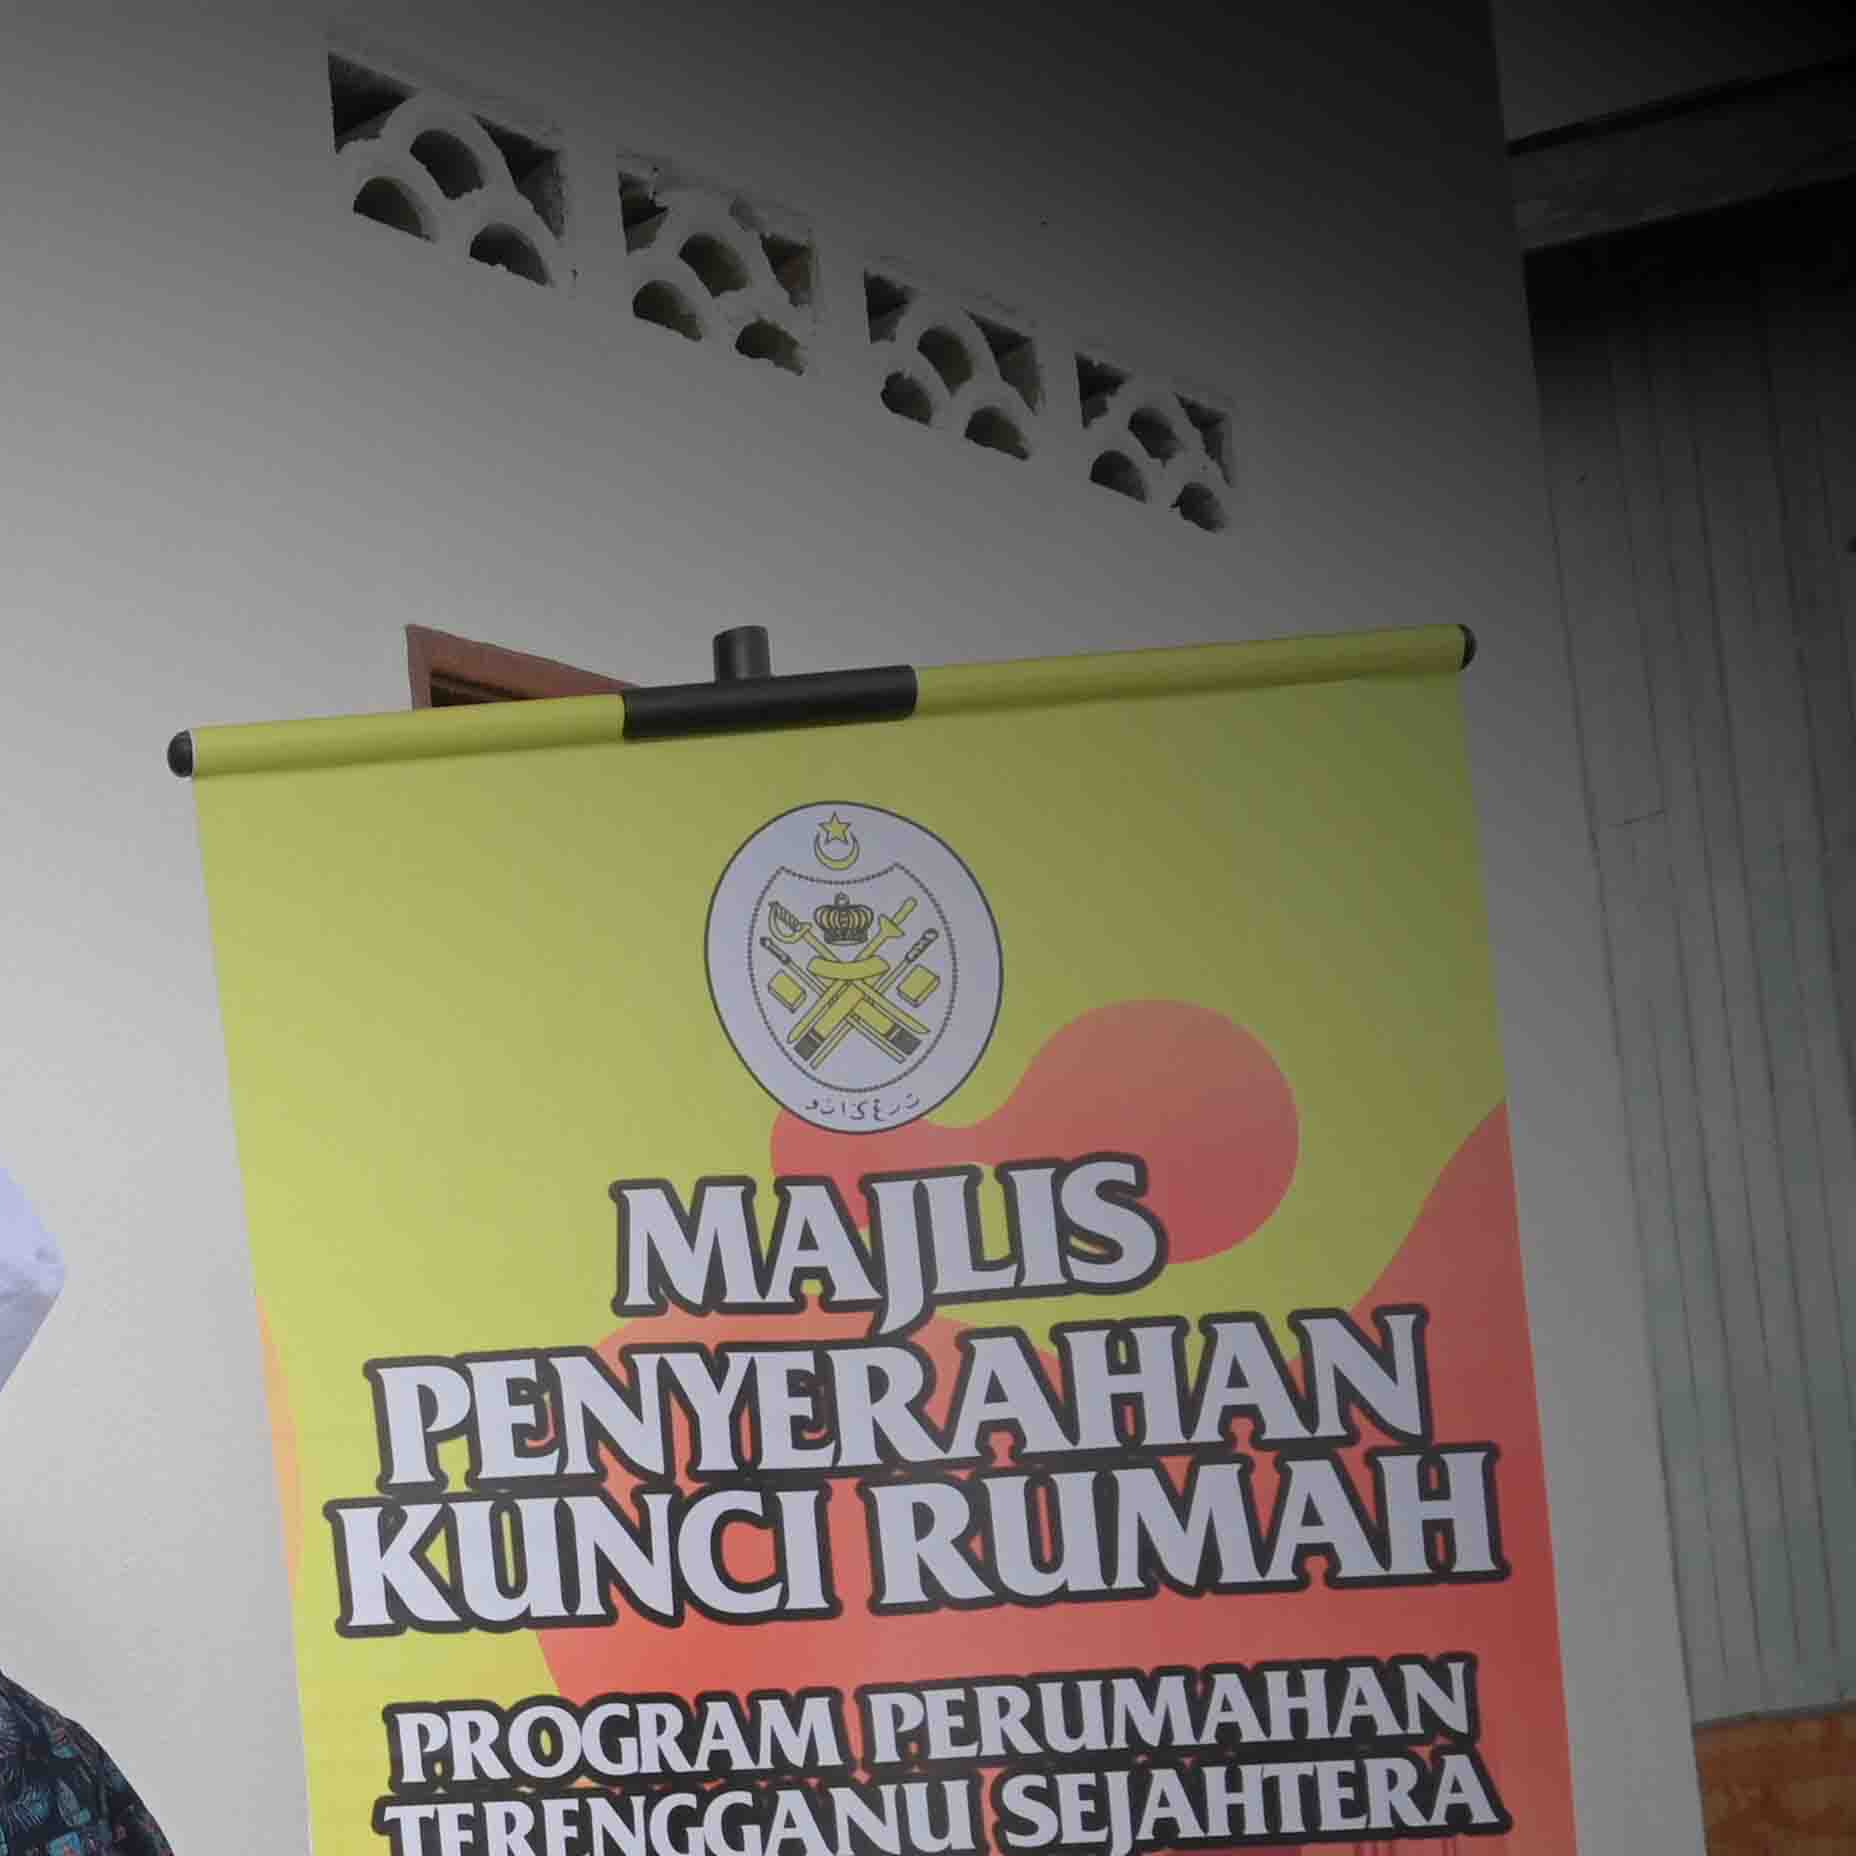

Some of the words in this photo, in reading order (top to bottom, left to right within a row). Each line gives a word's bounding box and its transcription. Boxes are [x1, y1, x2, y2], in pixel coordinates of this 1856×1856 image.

[616, 1157, 1160, 1337] MAJLIS
[373, 1311, 1429, 1486] PENYERAHAN
[335, 1488, 833, 1629] KUNCI
[865, 1449, 1502, 1606] RUMAH
[393, 1695, 846, 1786] PROGRAM
[866, 1660, 1474, 1765] PERUMAHAN
